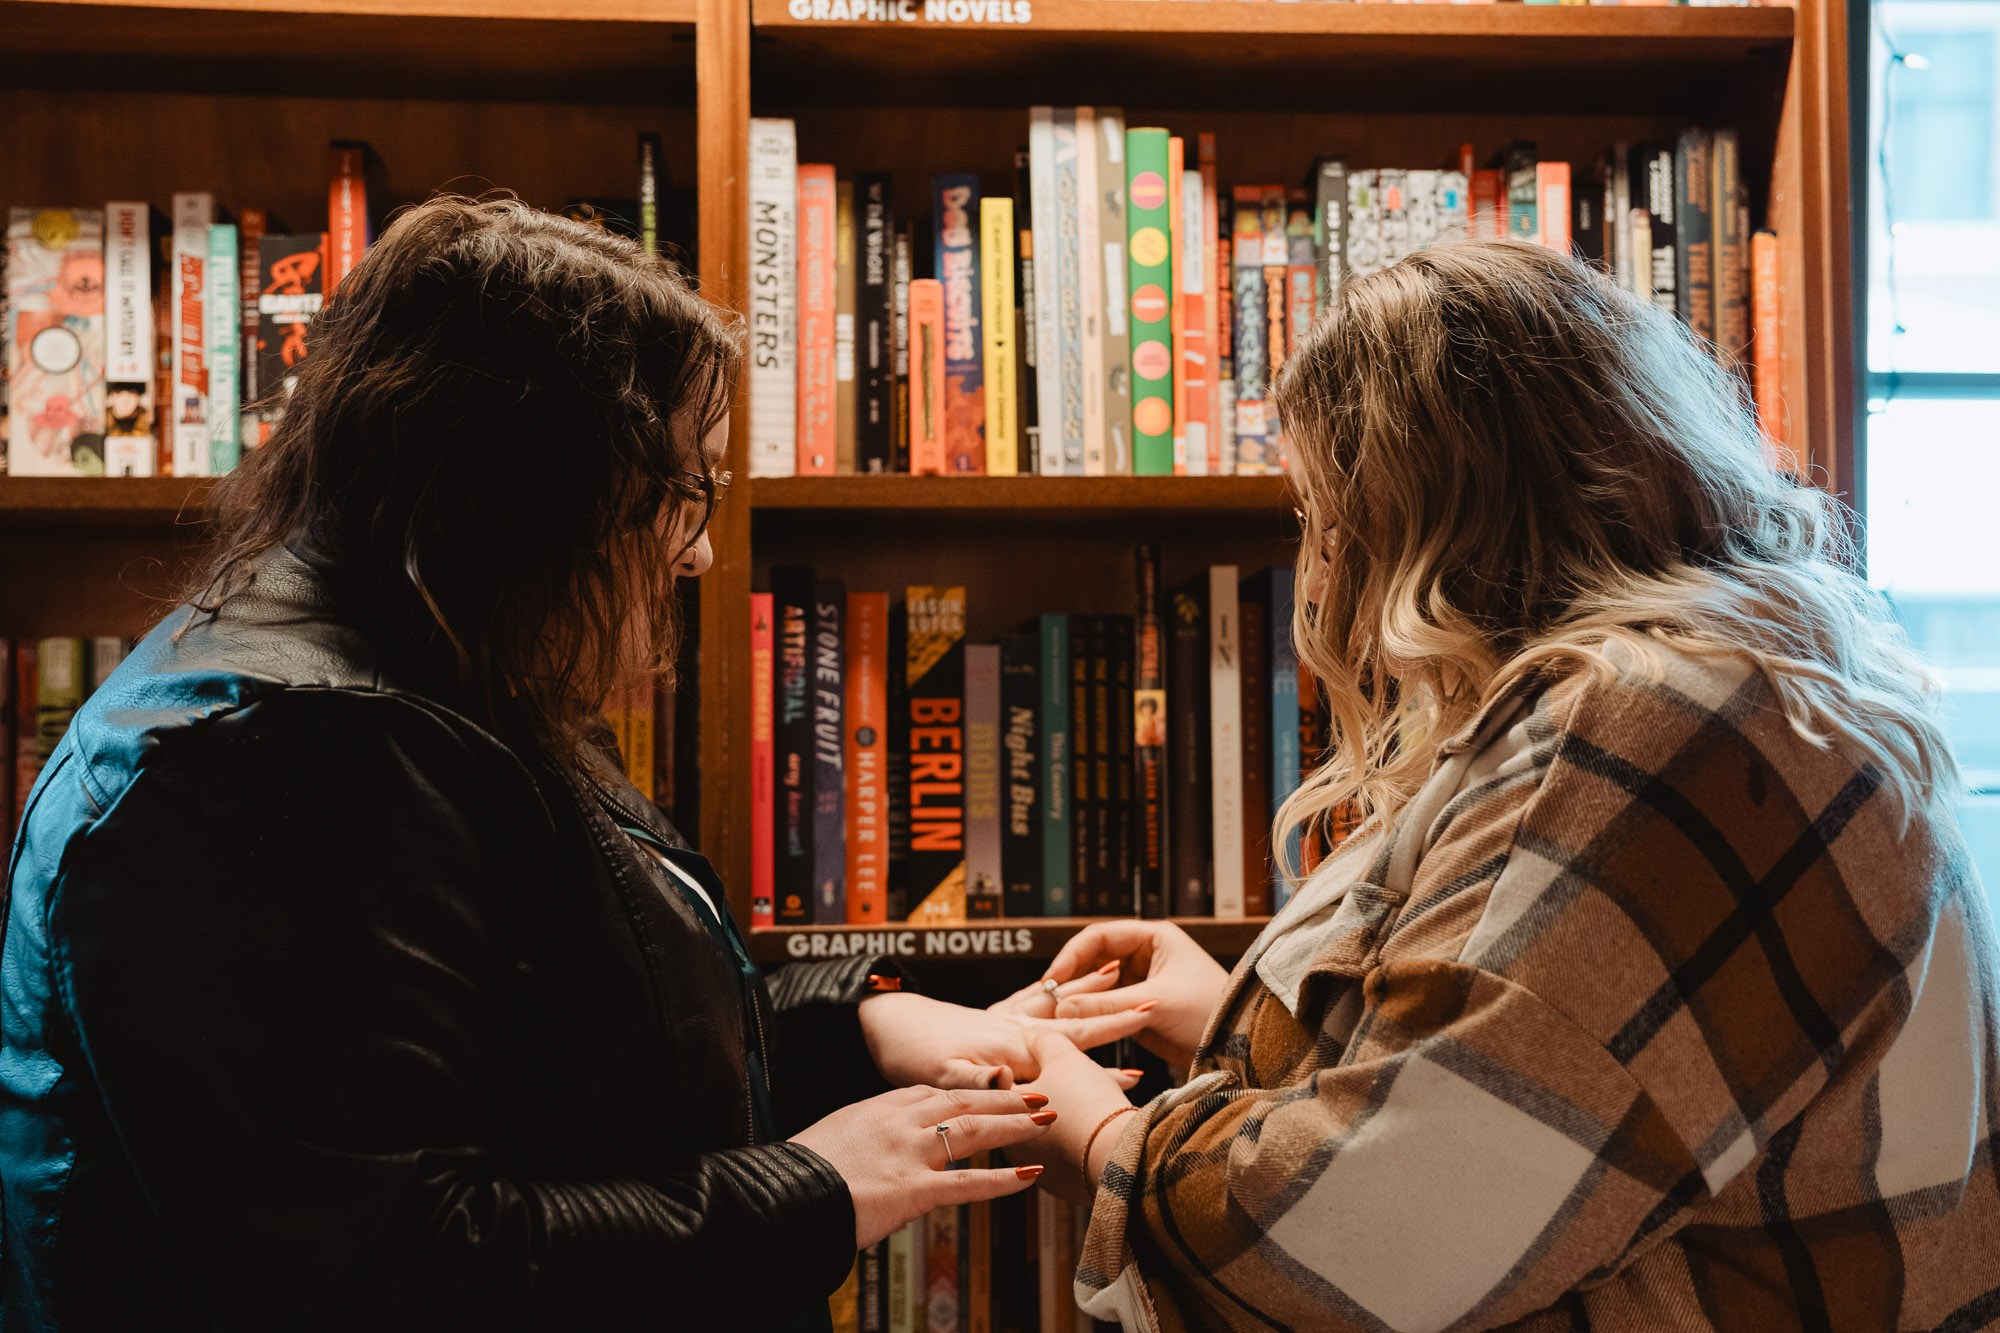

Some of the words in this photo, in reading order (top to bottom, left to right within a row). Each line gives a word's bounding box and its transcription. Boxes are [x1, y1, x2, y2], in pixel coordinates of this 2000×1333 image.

[788, 0, 917, 22] GRAPHIC
[925, 0, 1032, 23] NOVELS
[756, 201, 779, 370] MONSTERS
[784, 605, 805, 724] ARTIFICIAL
[817, 602, 840, 685] STONE
[816, 687, 842, 769] FRUIT
[1006, 705, 1034, 778] Night
[857, 752, 876, 843] HARPER
[910, 698, 963, 852] BERLIN
[969, 721, 995, 820] moms
[1010, 780, 1034, 836] Bus
[857, 853, 876, 892] LEE
[786, 932, 916, 957] GRAPHIC
[925, 929, 1032, 954] NOVELS
